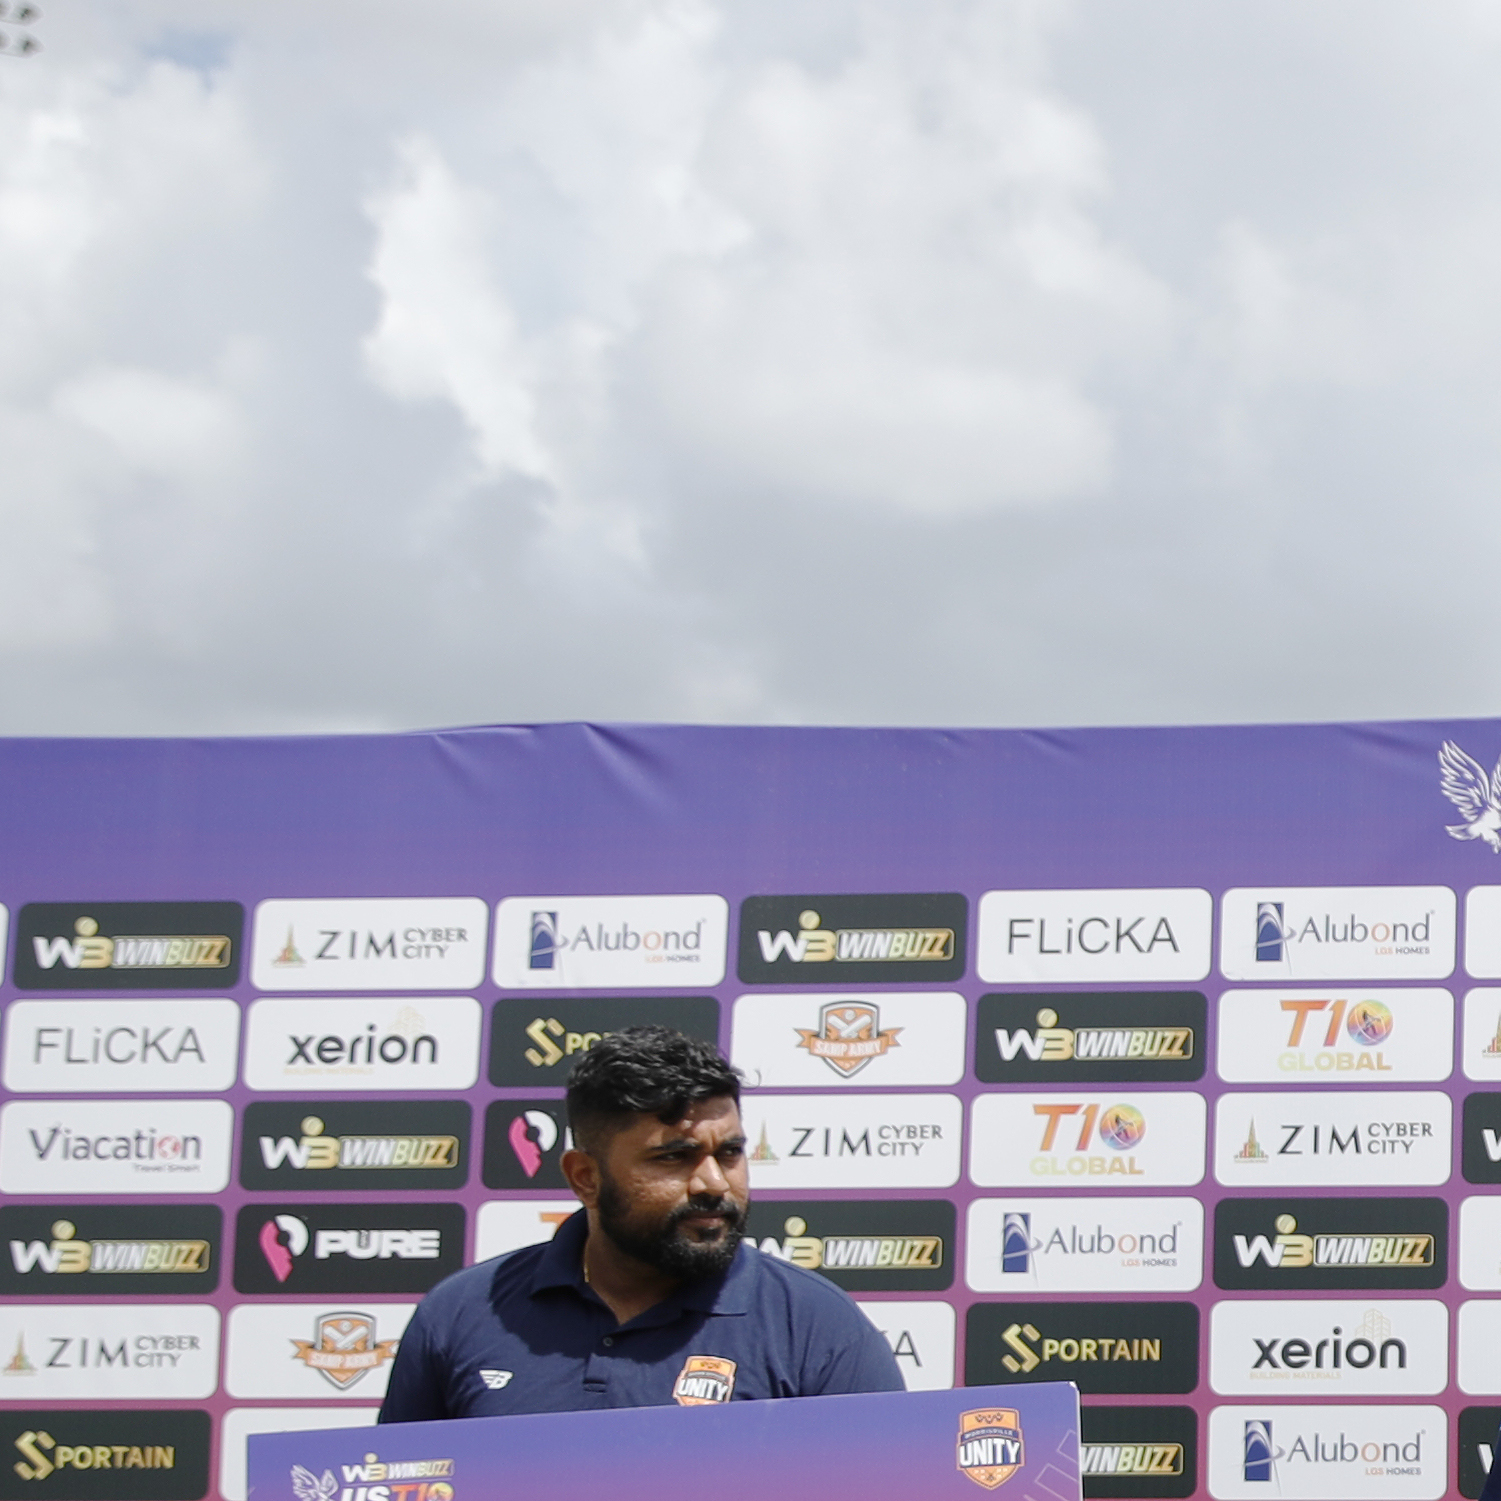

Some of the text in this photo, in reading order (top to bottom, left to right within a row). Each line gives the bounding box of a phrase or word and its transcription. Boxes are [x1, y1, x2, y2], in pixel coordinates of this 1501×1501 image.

[314, 928, 468, 960] ZIM CYBER
[572, 922, 703, 952] Alubond
[1010, 917, 1179, 954] FLiCKA
[1300, 913, 1431, 944] Alubond
[114, 937, 228, 968] WINBUZZ
[405, 943, 448, 960] CITY
[1375, 946, 1430, 955] LGS HOMES
[1280, 1000, 1394, 1048] T10
[34, 1028, 204, 1064] FLiCKA
[289, 1025, 436, 1066] xerion
[1279, 1053, 1391, 1072] GLOBAL
[30, 1126, 201, 1162] Viacation
[316, 1229, 440, 1260] PURE
[1253, 1326, 1407, 1370] xerion
[678, 1378, 728, 1400] UNITY
[960, 1439, 1020, 1466] UNITY
[1288, 1433, 1422, 1465] Alubond
